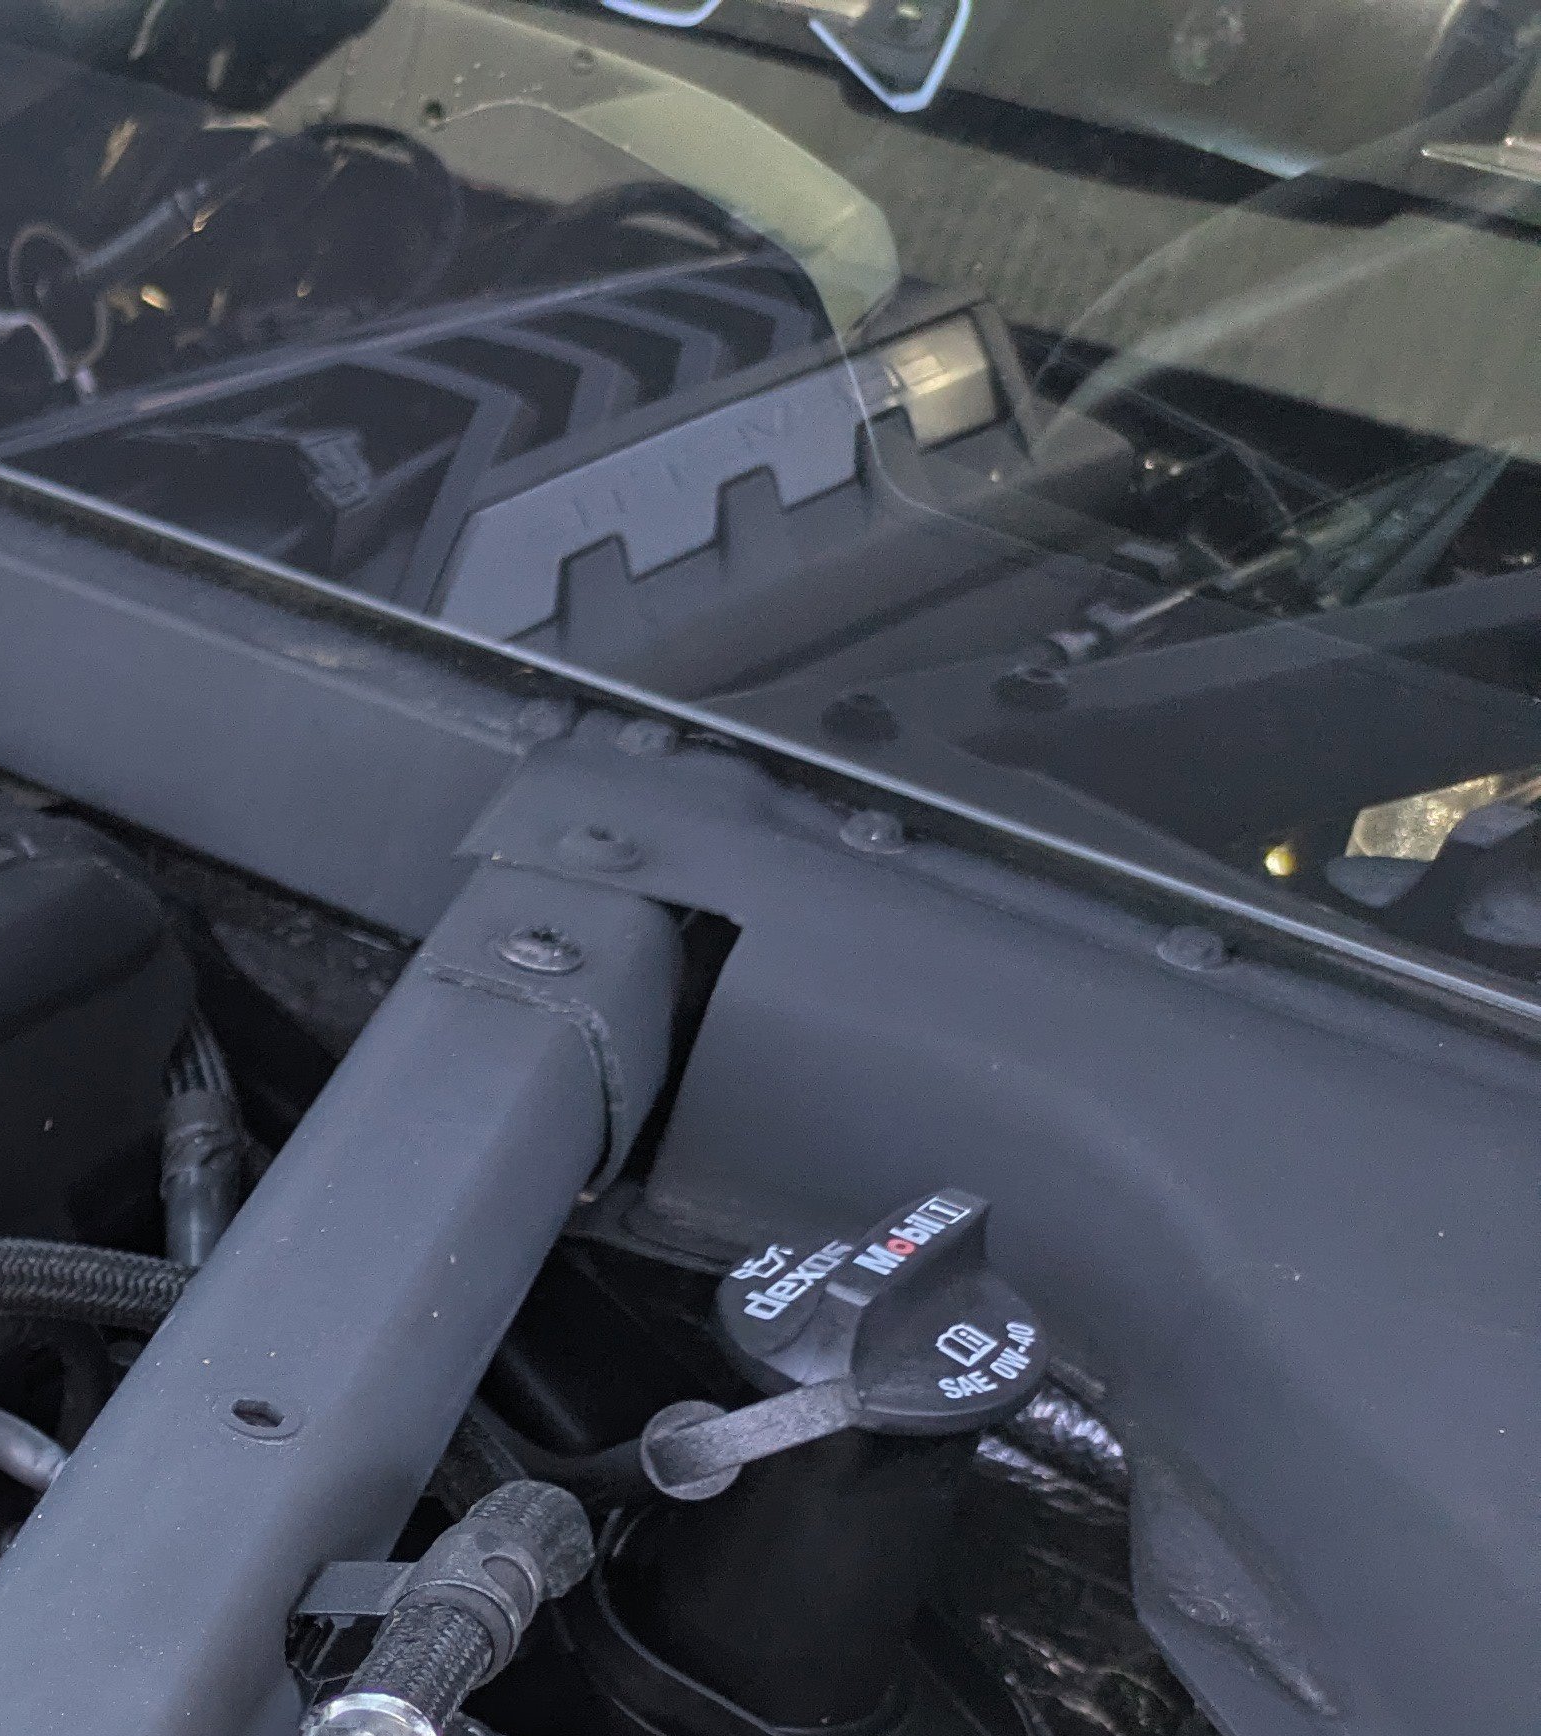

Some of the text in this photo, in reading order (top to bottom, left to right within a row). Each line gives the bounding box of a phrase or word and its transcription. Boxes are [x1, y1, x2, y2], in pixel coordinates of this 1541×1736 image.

[743, 1240, 853, 1320] dexos
[852, 1212, 946, 1276] Mobil
[938, 1321, 1035, 1399] SAE 0W-40
